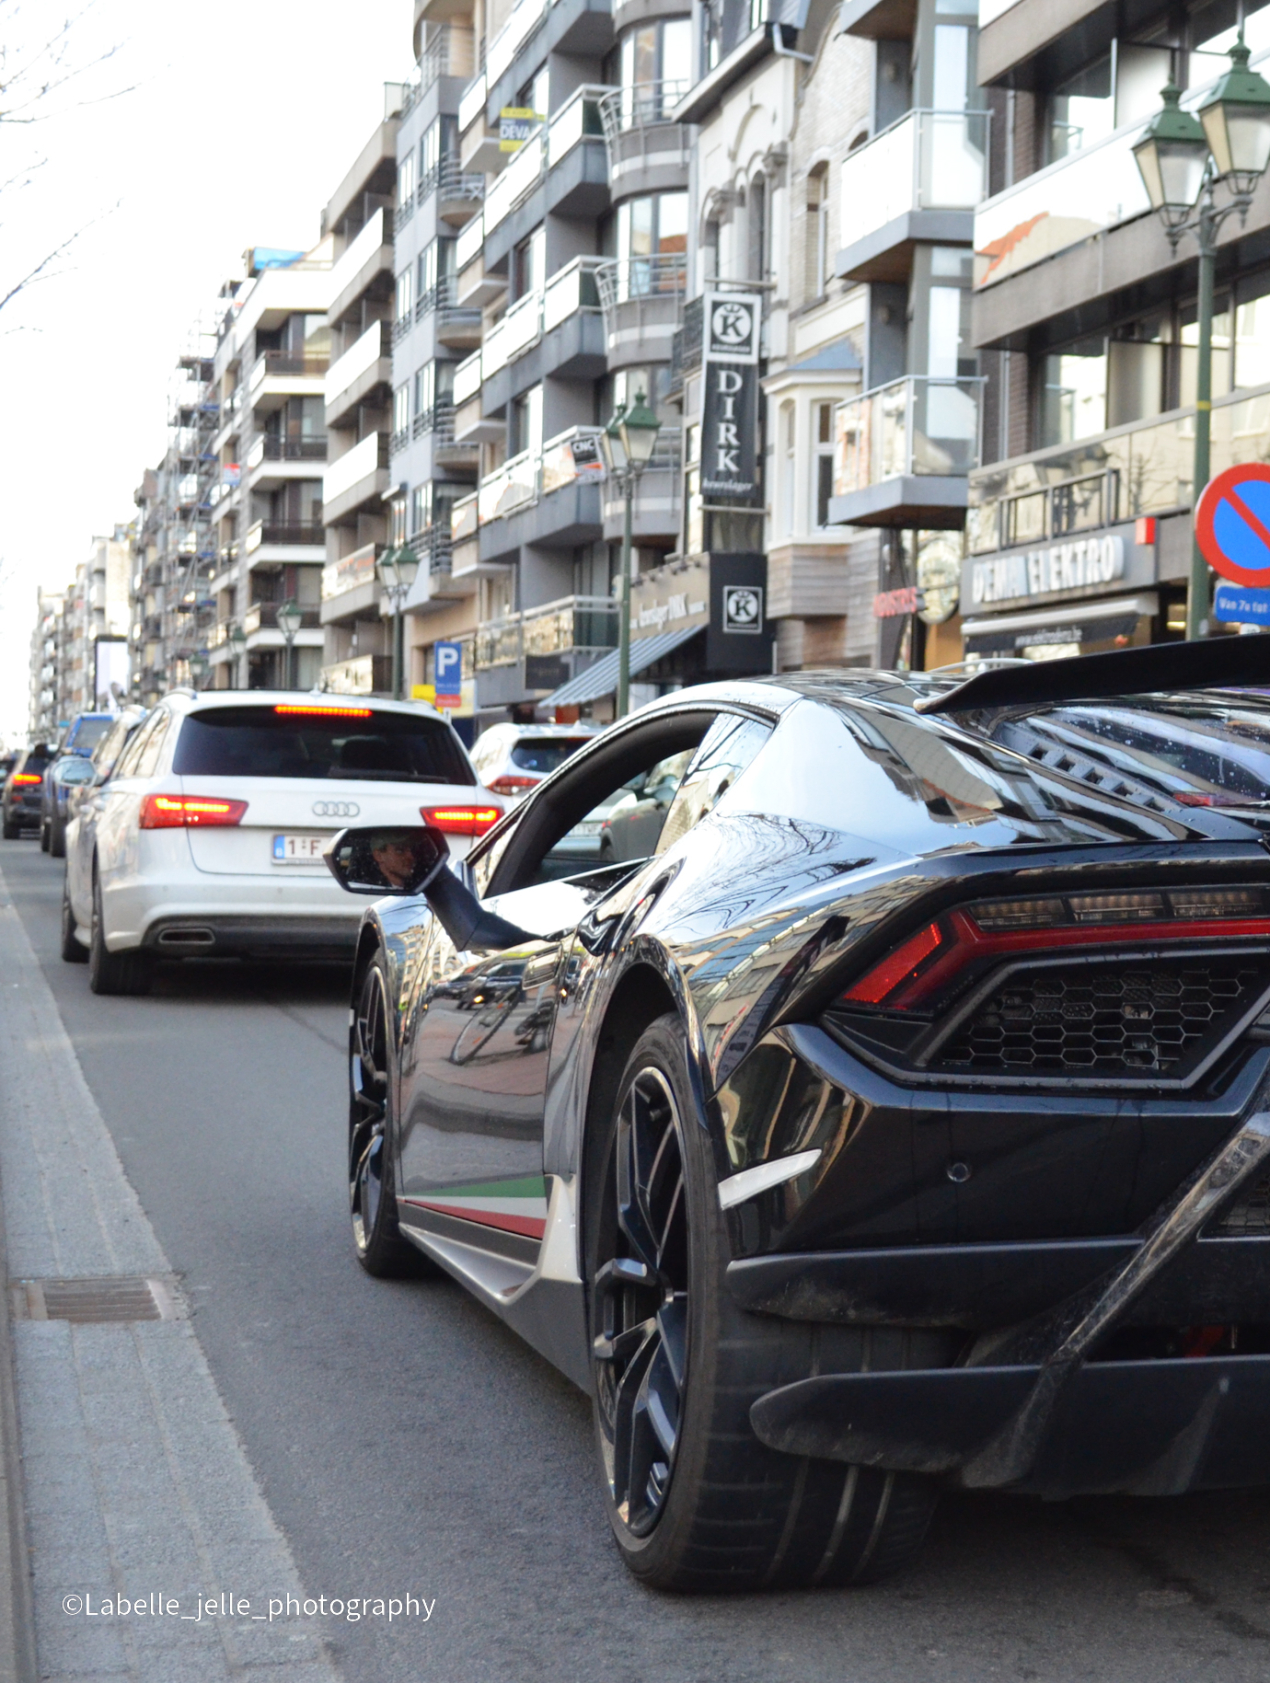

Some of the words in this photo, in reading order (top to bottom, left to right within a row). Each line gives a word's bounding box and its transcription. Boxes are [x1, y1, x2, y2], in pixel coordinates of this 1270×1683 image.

[717, 369, 743, 472] DIRK
[1027, 534, 1124, 595] ELEKTRO
[1219, 597, 1237, 610] Van
[1239, 600, 1251, 612] 7u
[1252, 602, 1268, 613] tot
[438, 647, 459, 677] P
